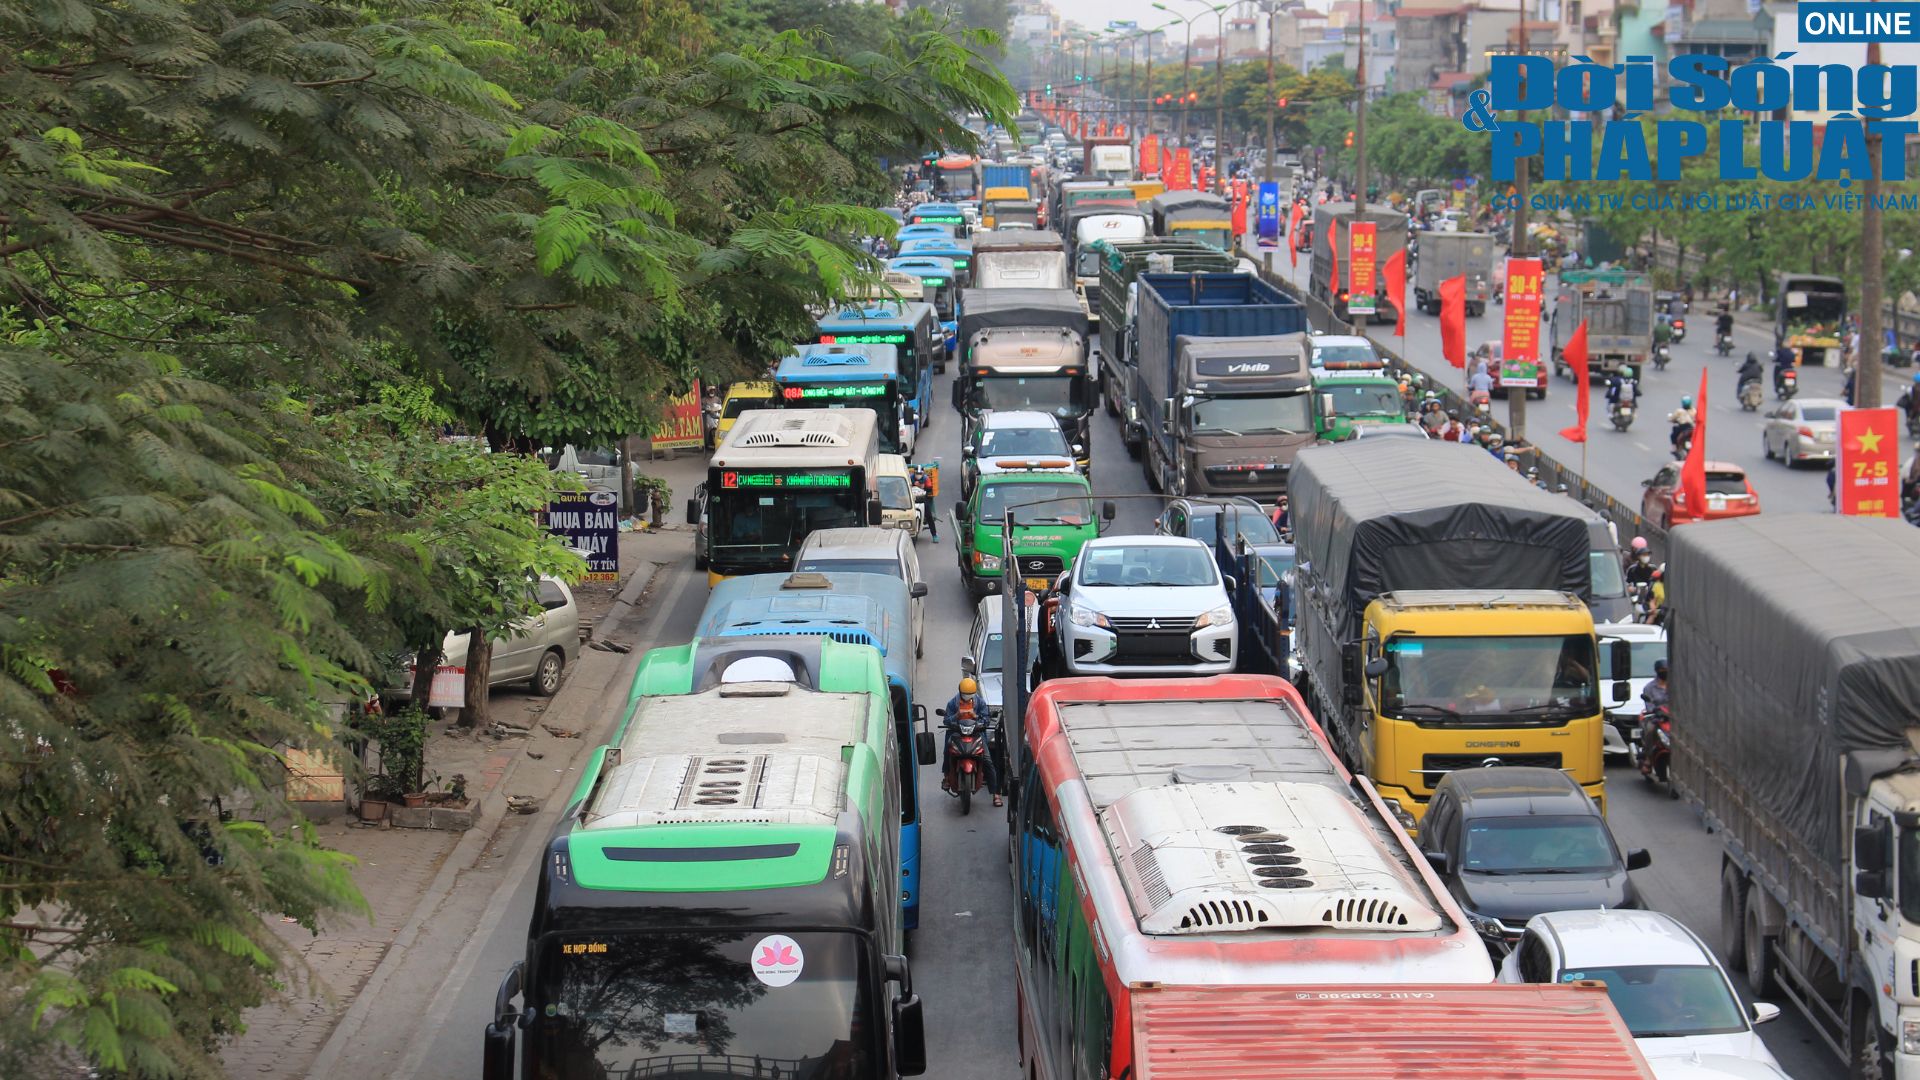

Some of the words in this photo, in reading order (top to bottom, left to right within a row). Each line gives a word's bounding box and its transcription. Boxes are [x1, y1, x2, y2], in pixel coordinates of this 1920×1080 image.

[1509, 274, 1538, 294] 30-4
[1853, 461, 1888, 478] 7-5
[723, 472, 736, 487] 12
[550, 512, 580, 529] MUA
[585, 508, 614, 529] BÁN
[578, 532, 608, 553] MÁY
[601, 557, 616, 570] TÍN
[600, 573, 615, 581] 362
[563, 944, 572, 954] XE
[573, 944, 587, 955] HỢP
